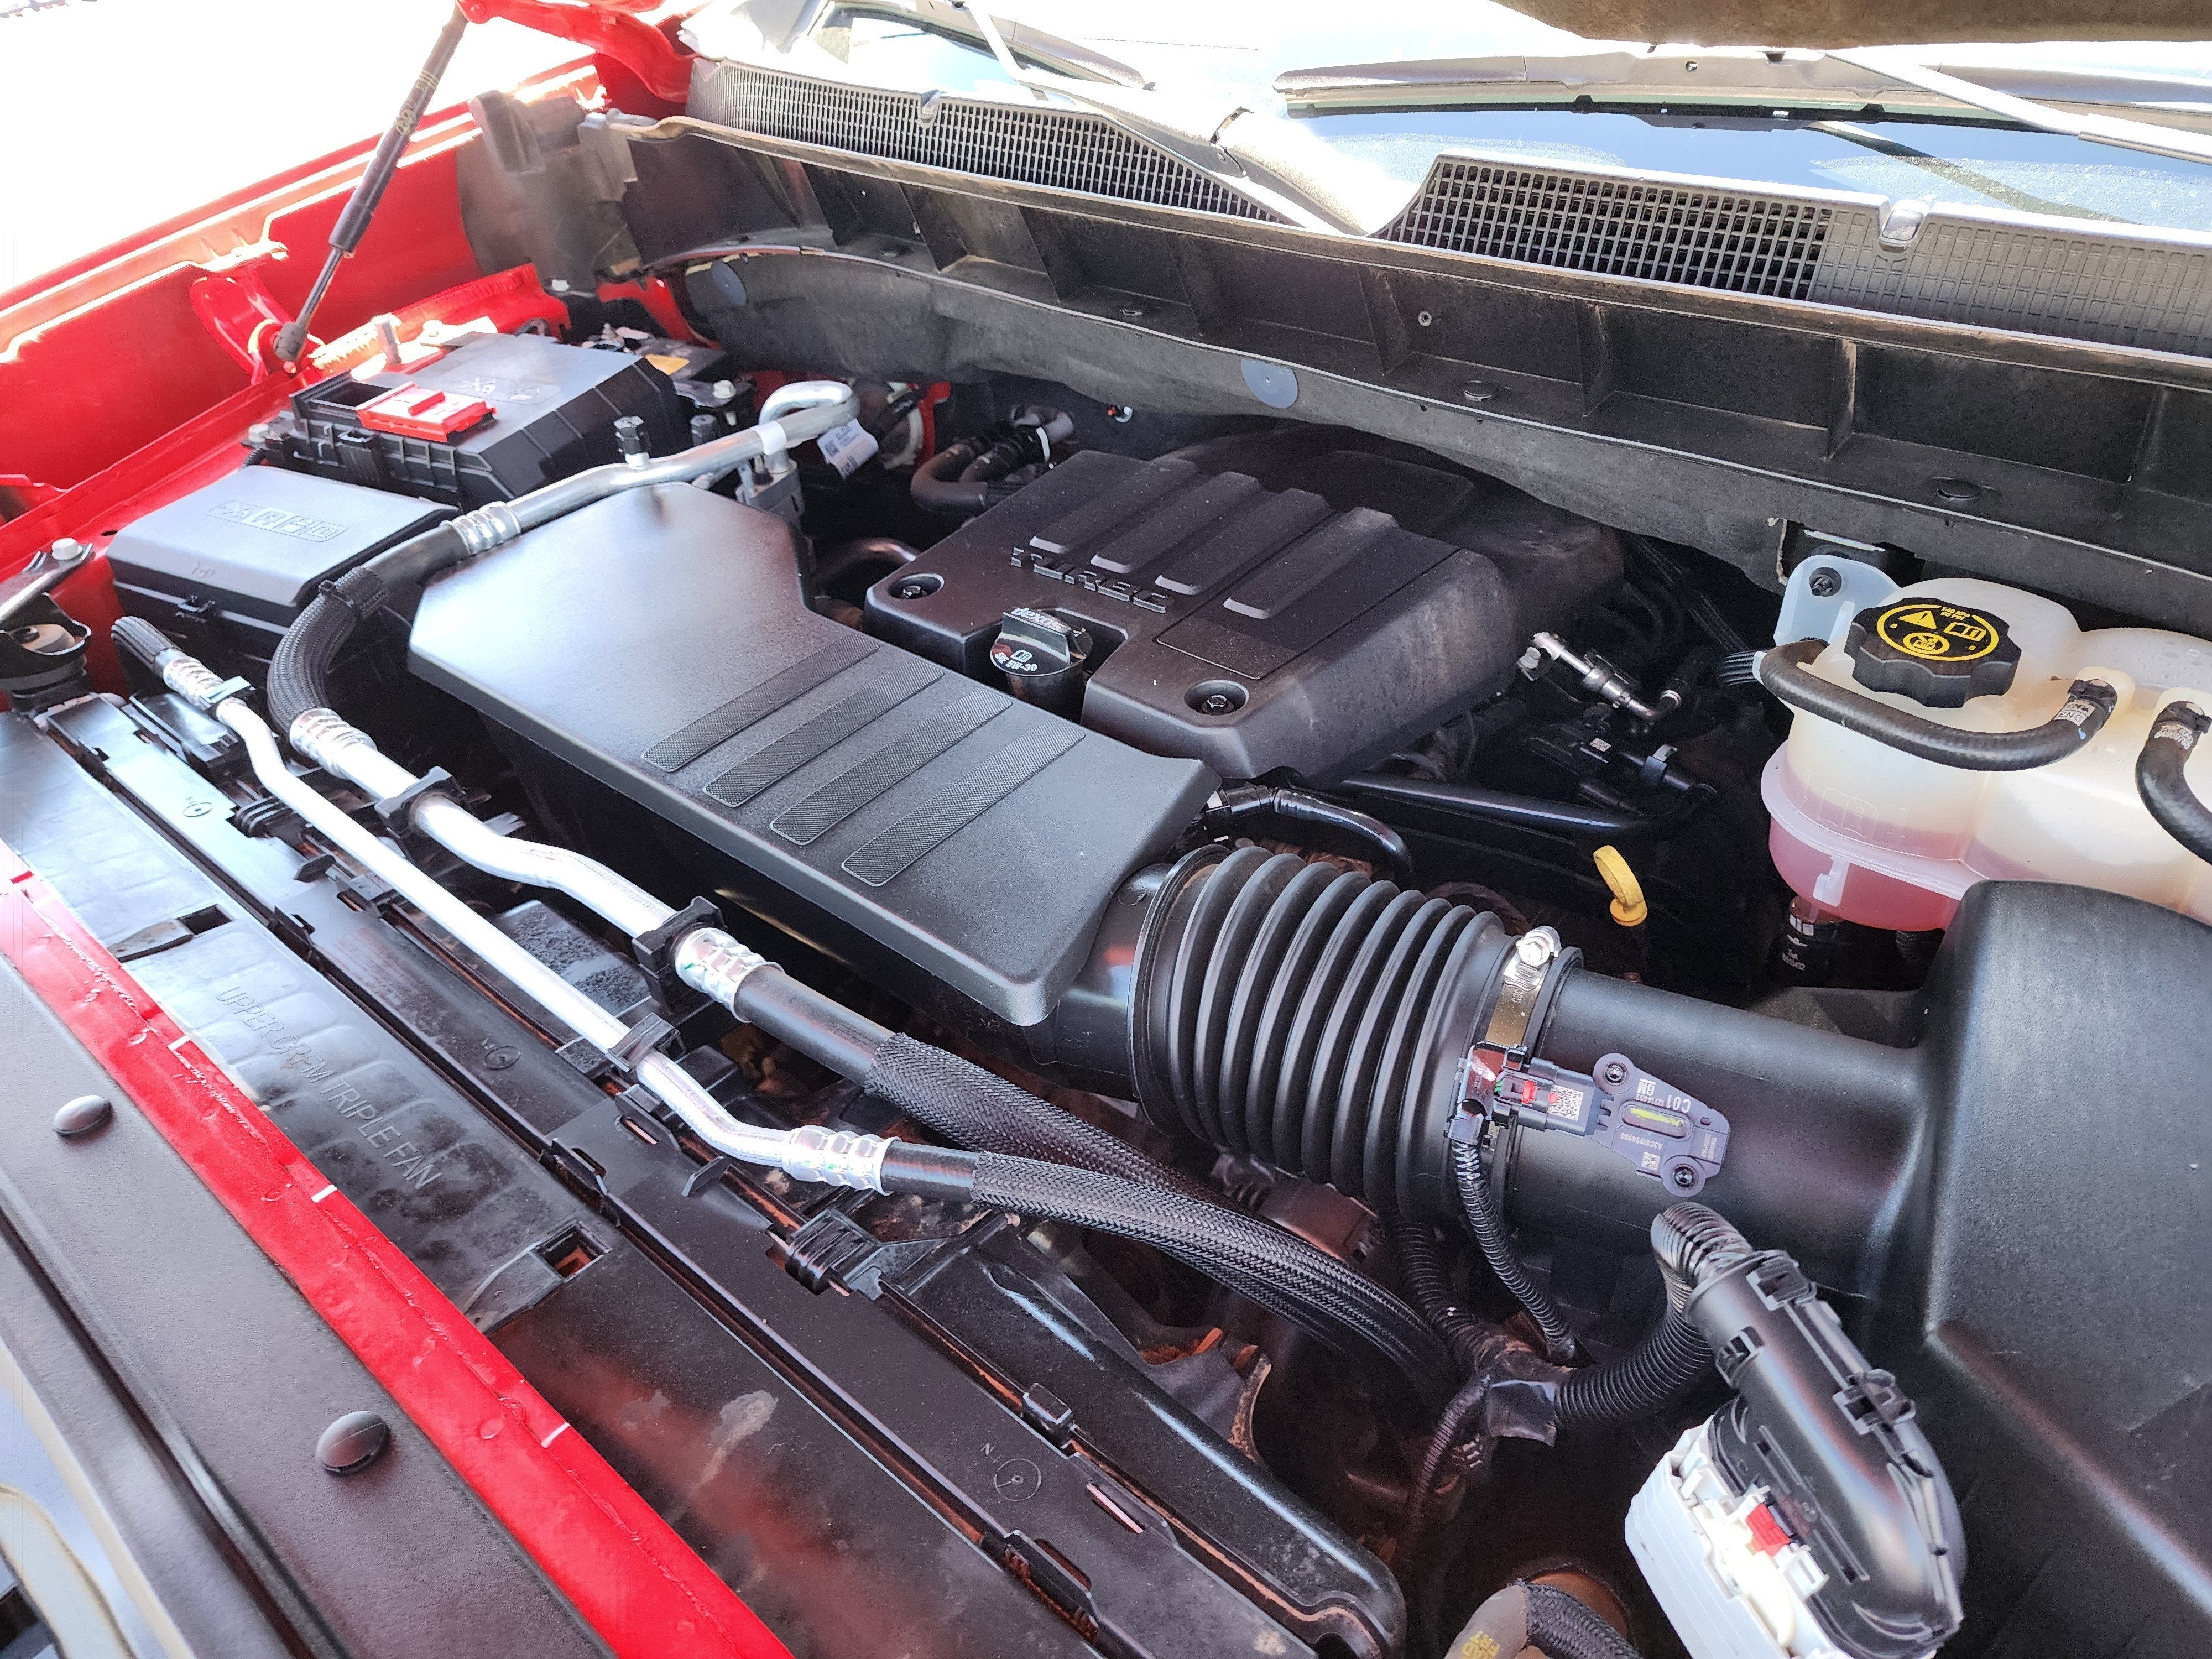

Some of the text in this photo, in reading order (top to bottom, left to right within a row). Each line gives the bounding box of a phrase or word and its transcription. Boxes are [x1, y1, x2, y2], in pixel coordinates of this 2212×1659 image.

[1005, 660, 1037, 671] 5W-30
[216, 986, 285, 1039] UPPER
[320, 1078, 402, 1149] TRIPLE
[383, 1141, 443, 1190] FAN
[1636, 1080, 1656, 1097] GM
